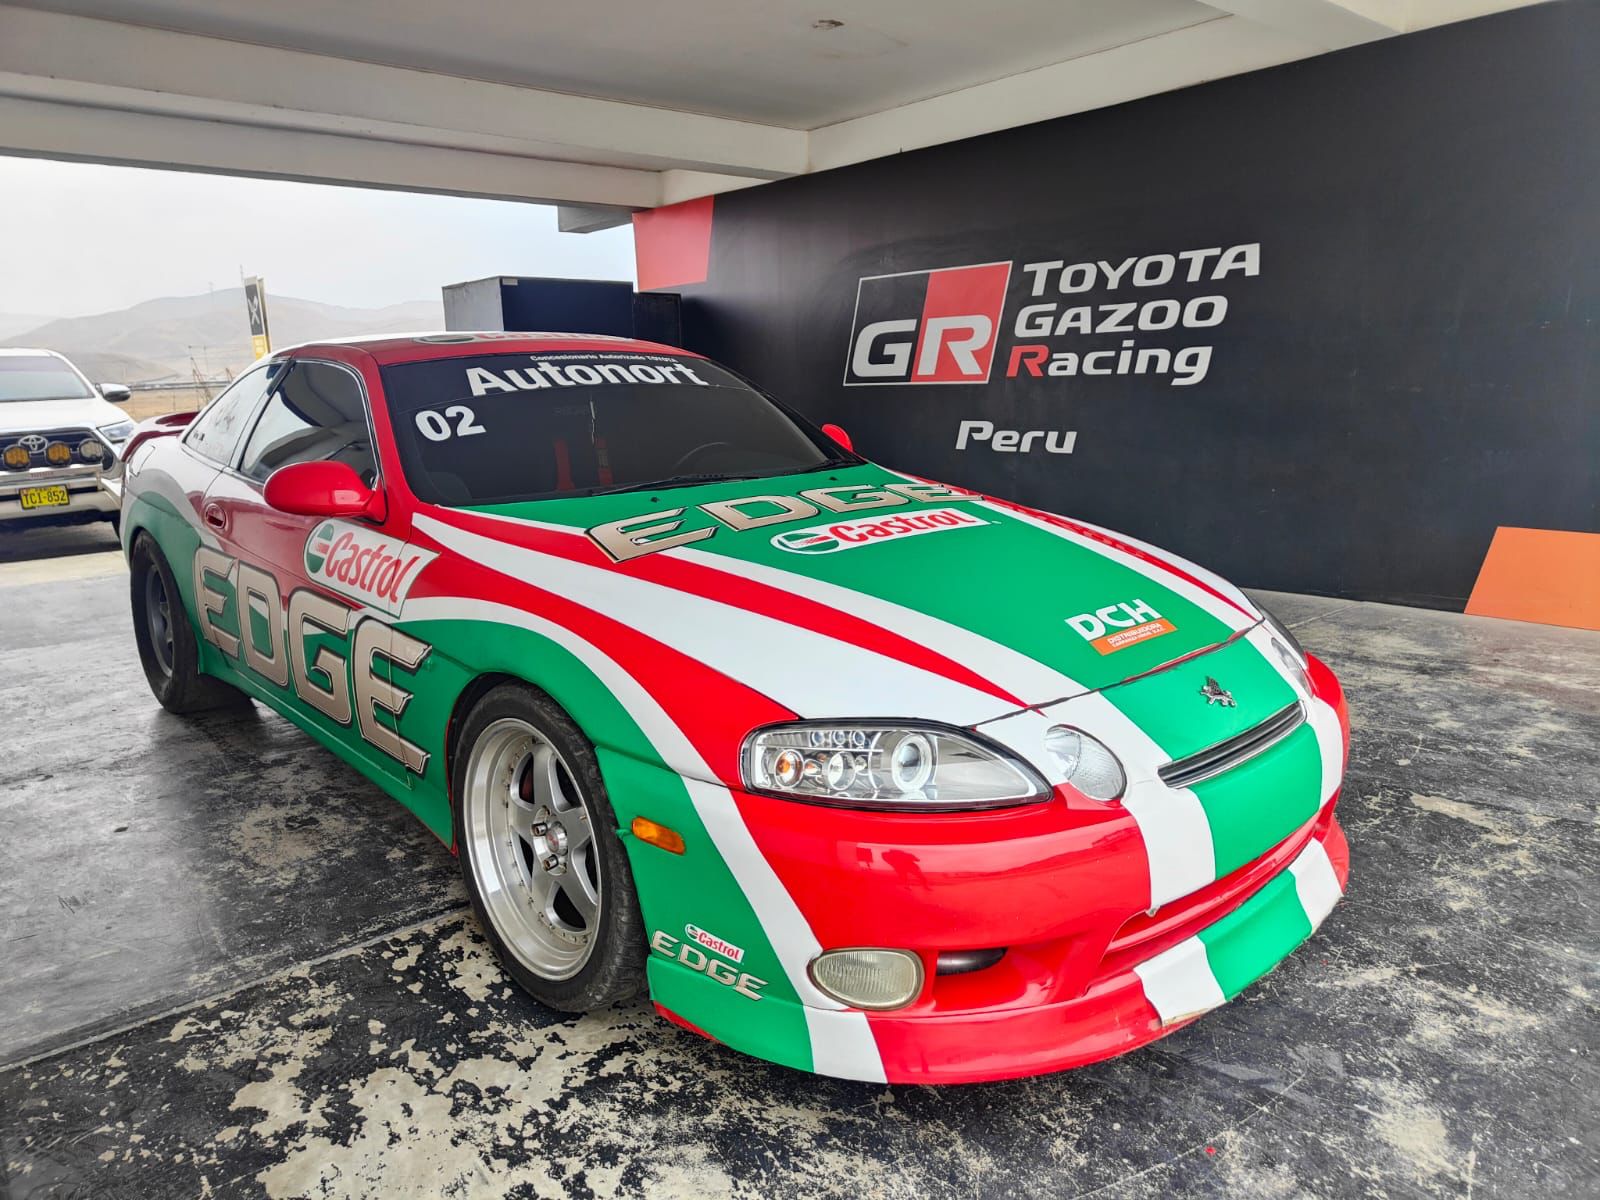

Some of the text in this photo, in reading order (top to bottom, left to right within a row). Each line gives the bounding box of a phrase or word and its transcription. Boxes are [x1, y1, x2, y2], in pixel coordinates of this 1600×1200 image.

[851, 313, 994, 378] GR
[1005, 338, 1214, 386] Racing
[465, 360, 709, 397] Autonort
[414, 404, 487, 442] 02
[954, 419, 1078, 455] Peru
[584, 482, 984, 563] EDGE
[827, 508, 978, 543] Castrol
[324, 531, 420, 604] Castrol
[1063, 598, 1163, 641] DCH
[192, 544, 433, 777] EDGE
[650, 930, 769, 1001] EDGE
[698, 931, 740, 961] Castrol
